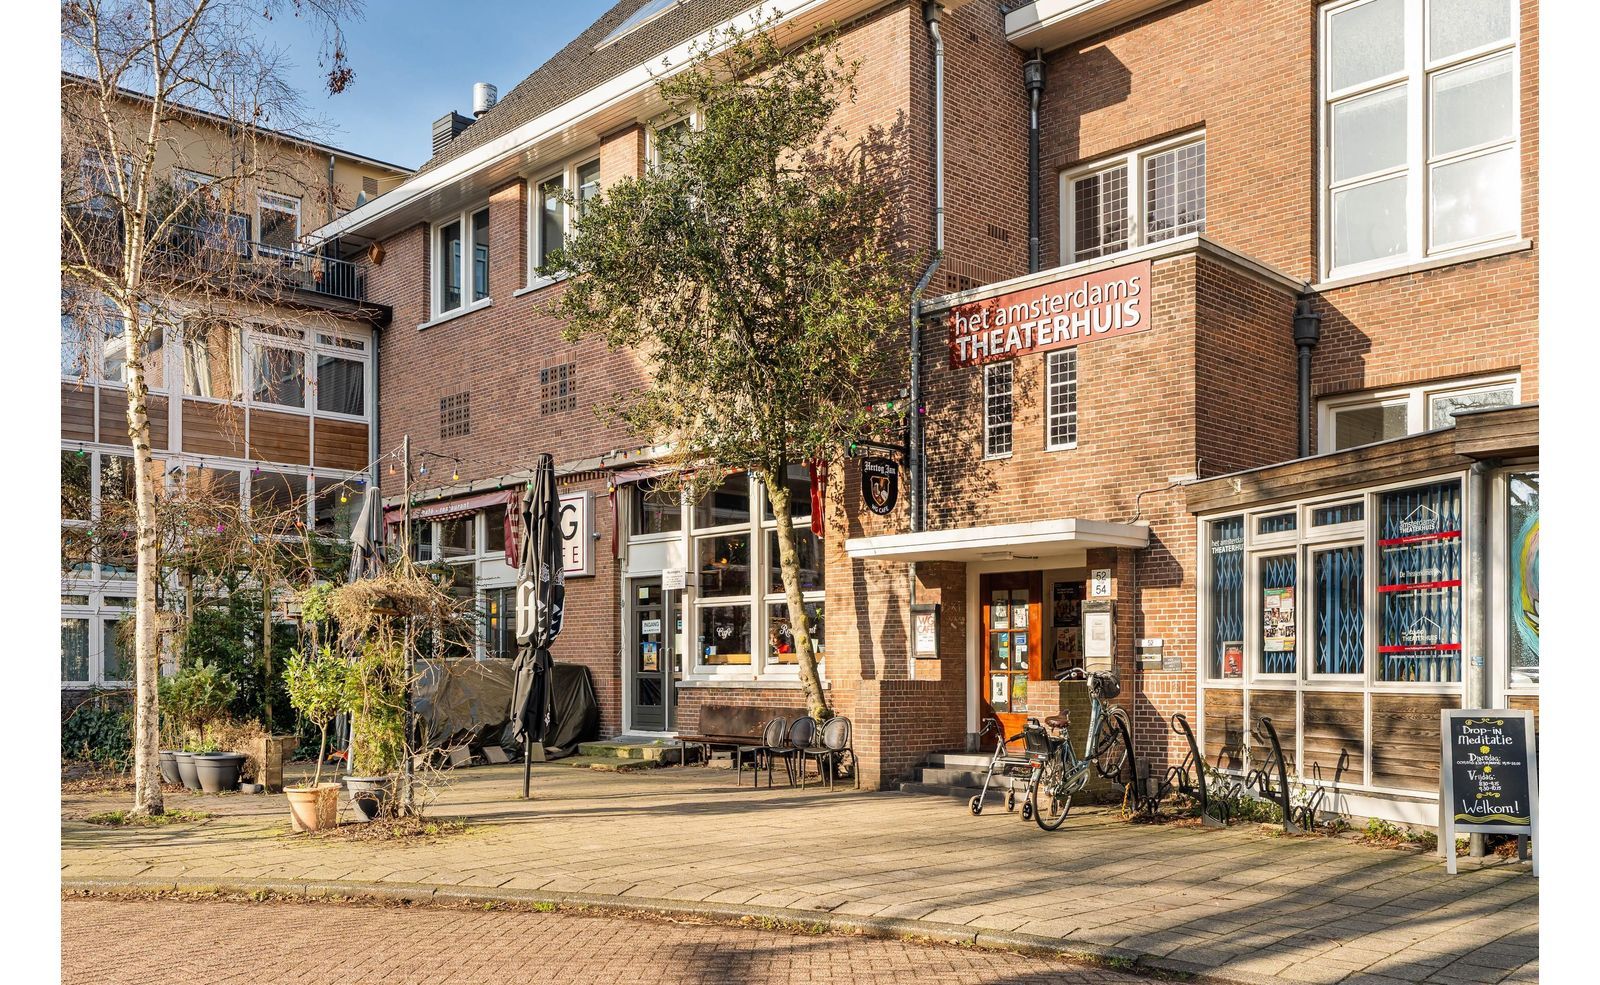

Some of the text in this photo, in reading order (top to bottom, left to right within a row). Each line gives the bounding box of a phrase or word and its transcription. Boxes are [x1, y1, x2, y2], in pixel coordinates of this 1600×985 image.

[955, 275, 1142, 337] het amsterdams
[955, 298, 1141, 362] THEATERHUIS
[864, 461, 896, 476] Hertog Jan
[559, 504, 578, 541] G
[1095, 571, 1107, 581] 52
[1095, 585, 1107, 595] 54
[917, 616, 935, 626] WG
[1462, 799, 1520, 814] Welkom!
